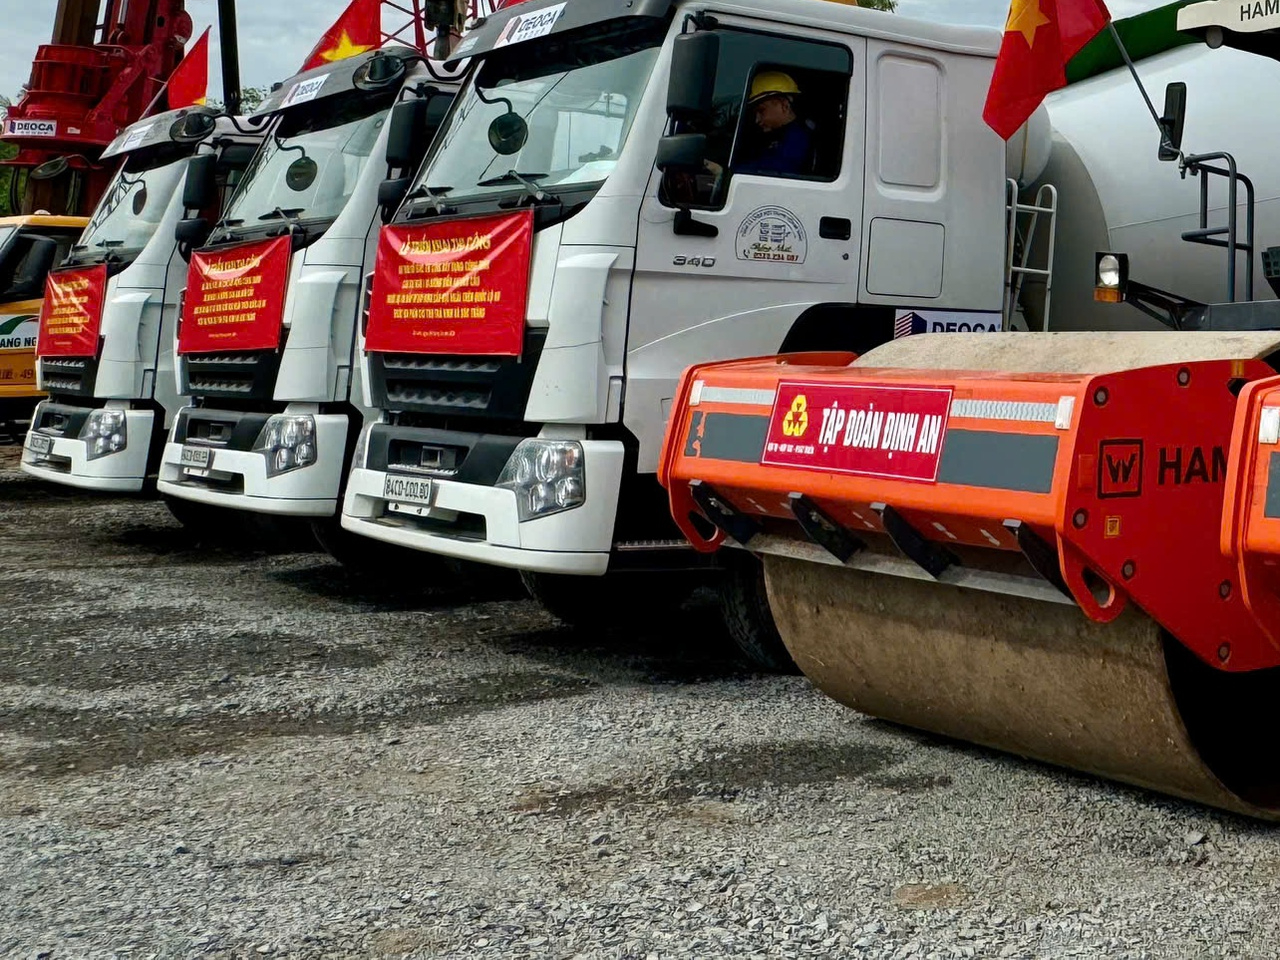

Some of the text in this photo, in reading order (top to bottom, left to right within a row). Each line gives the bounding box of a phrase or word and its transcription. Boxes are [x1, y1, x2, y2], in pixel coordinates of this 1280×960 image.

[673, 255, 716, 268] 340
[819, 401, 845, 452] TẬP
[881, 412, 919, 459] ĐỊNH
[916, 414, 942, 454] AN
